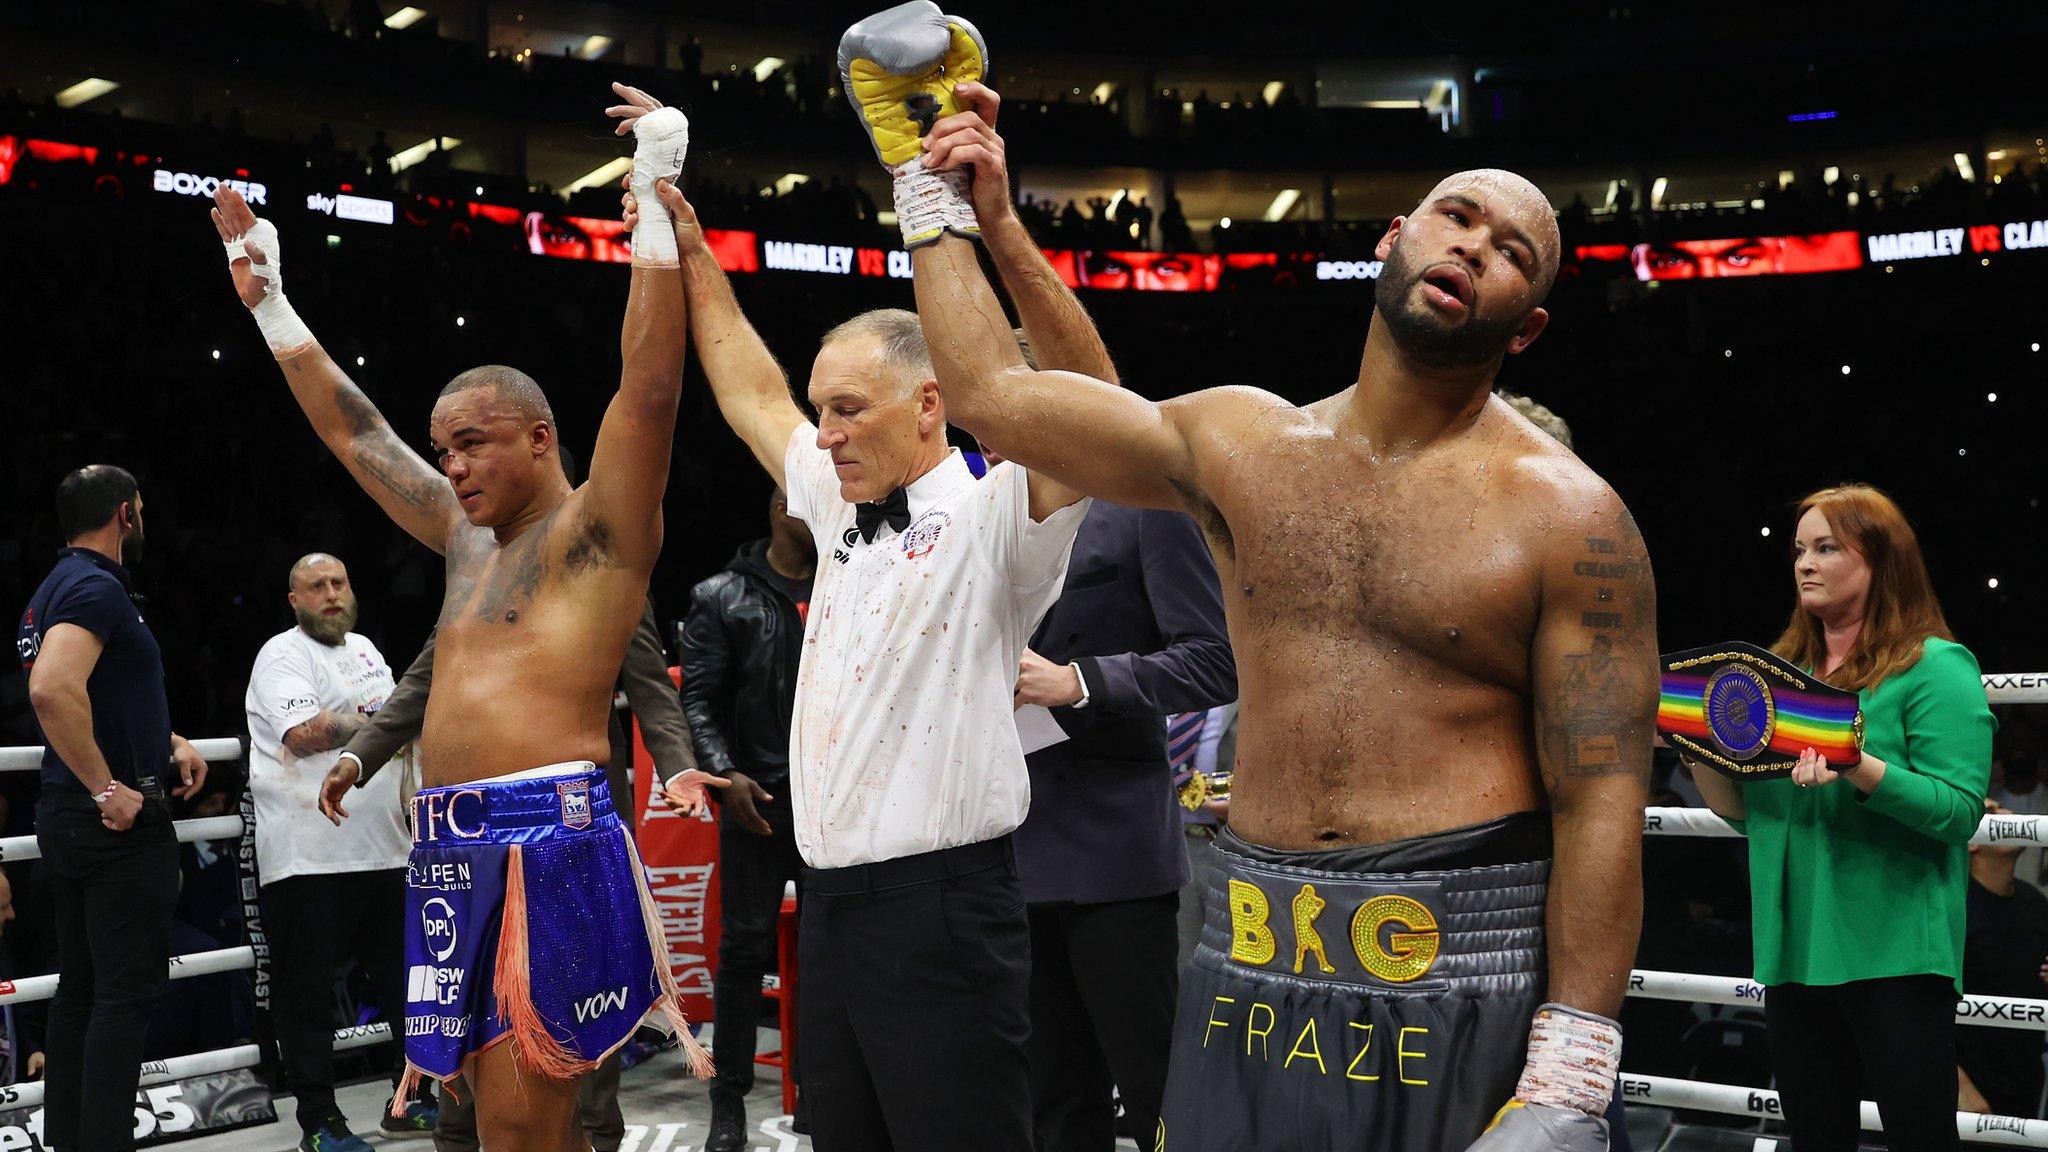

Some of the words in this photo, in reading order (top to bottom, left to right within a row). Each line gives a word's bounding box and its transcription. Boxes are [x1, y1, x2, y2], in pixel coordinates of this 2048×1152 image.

[307, 193, 335, 215] sky
[765, 241, 854, 275] WARDLEY
[857, 247, 885, 277] VS
[1868, 228, 1964, 262] WARDLEY
[1969, 224, 2000, 254] VS
[240, 780, 257, 873] VERLAST
[1989, 819, 2039, 842] EVERLAST
[427, 920, 451, 937] DPL
[645, 862, 715, 999] EVERLAST
[245, 904, 271, 1011] EVERLAST
[574, 986, 629, 1024] VOW
[1735, 983, 1766, 1002] sky
[1204, 996, 1429, 1086] FRAZE
